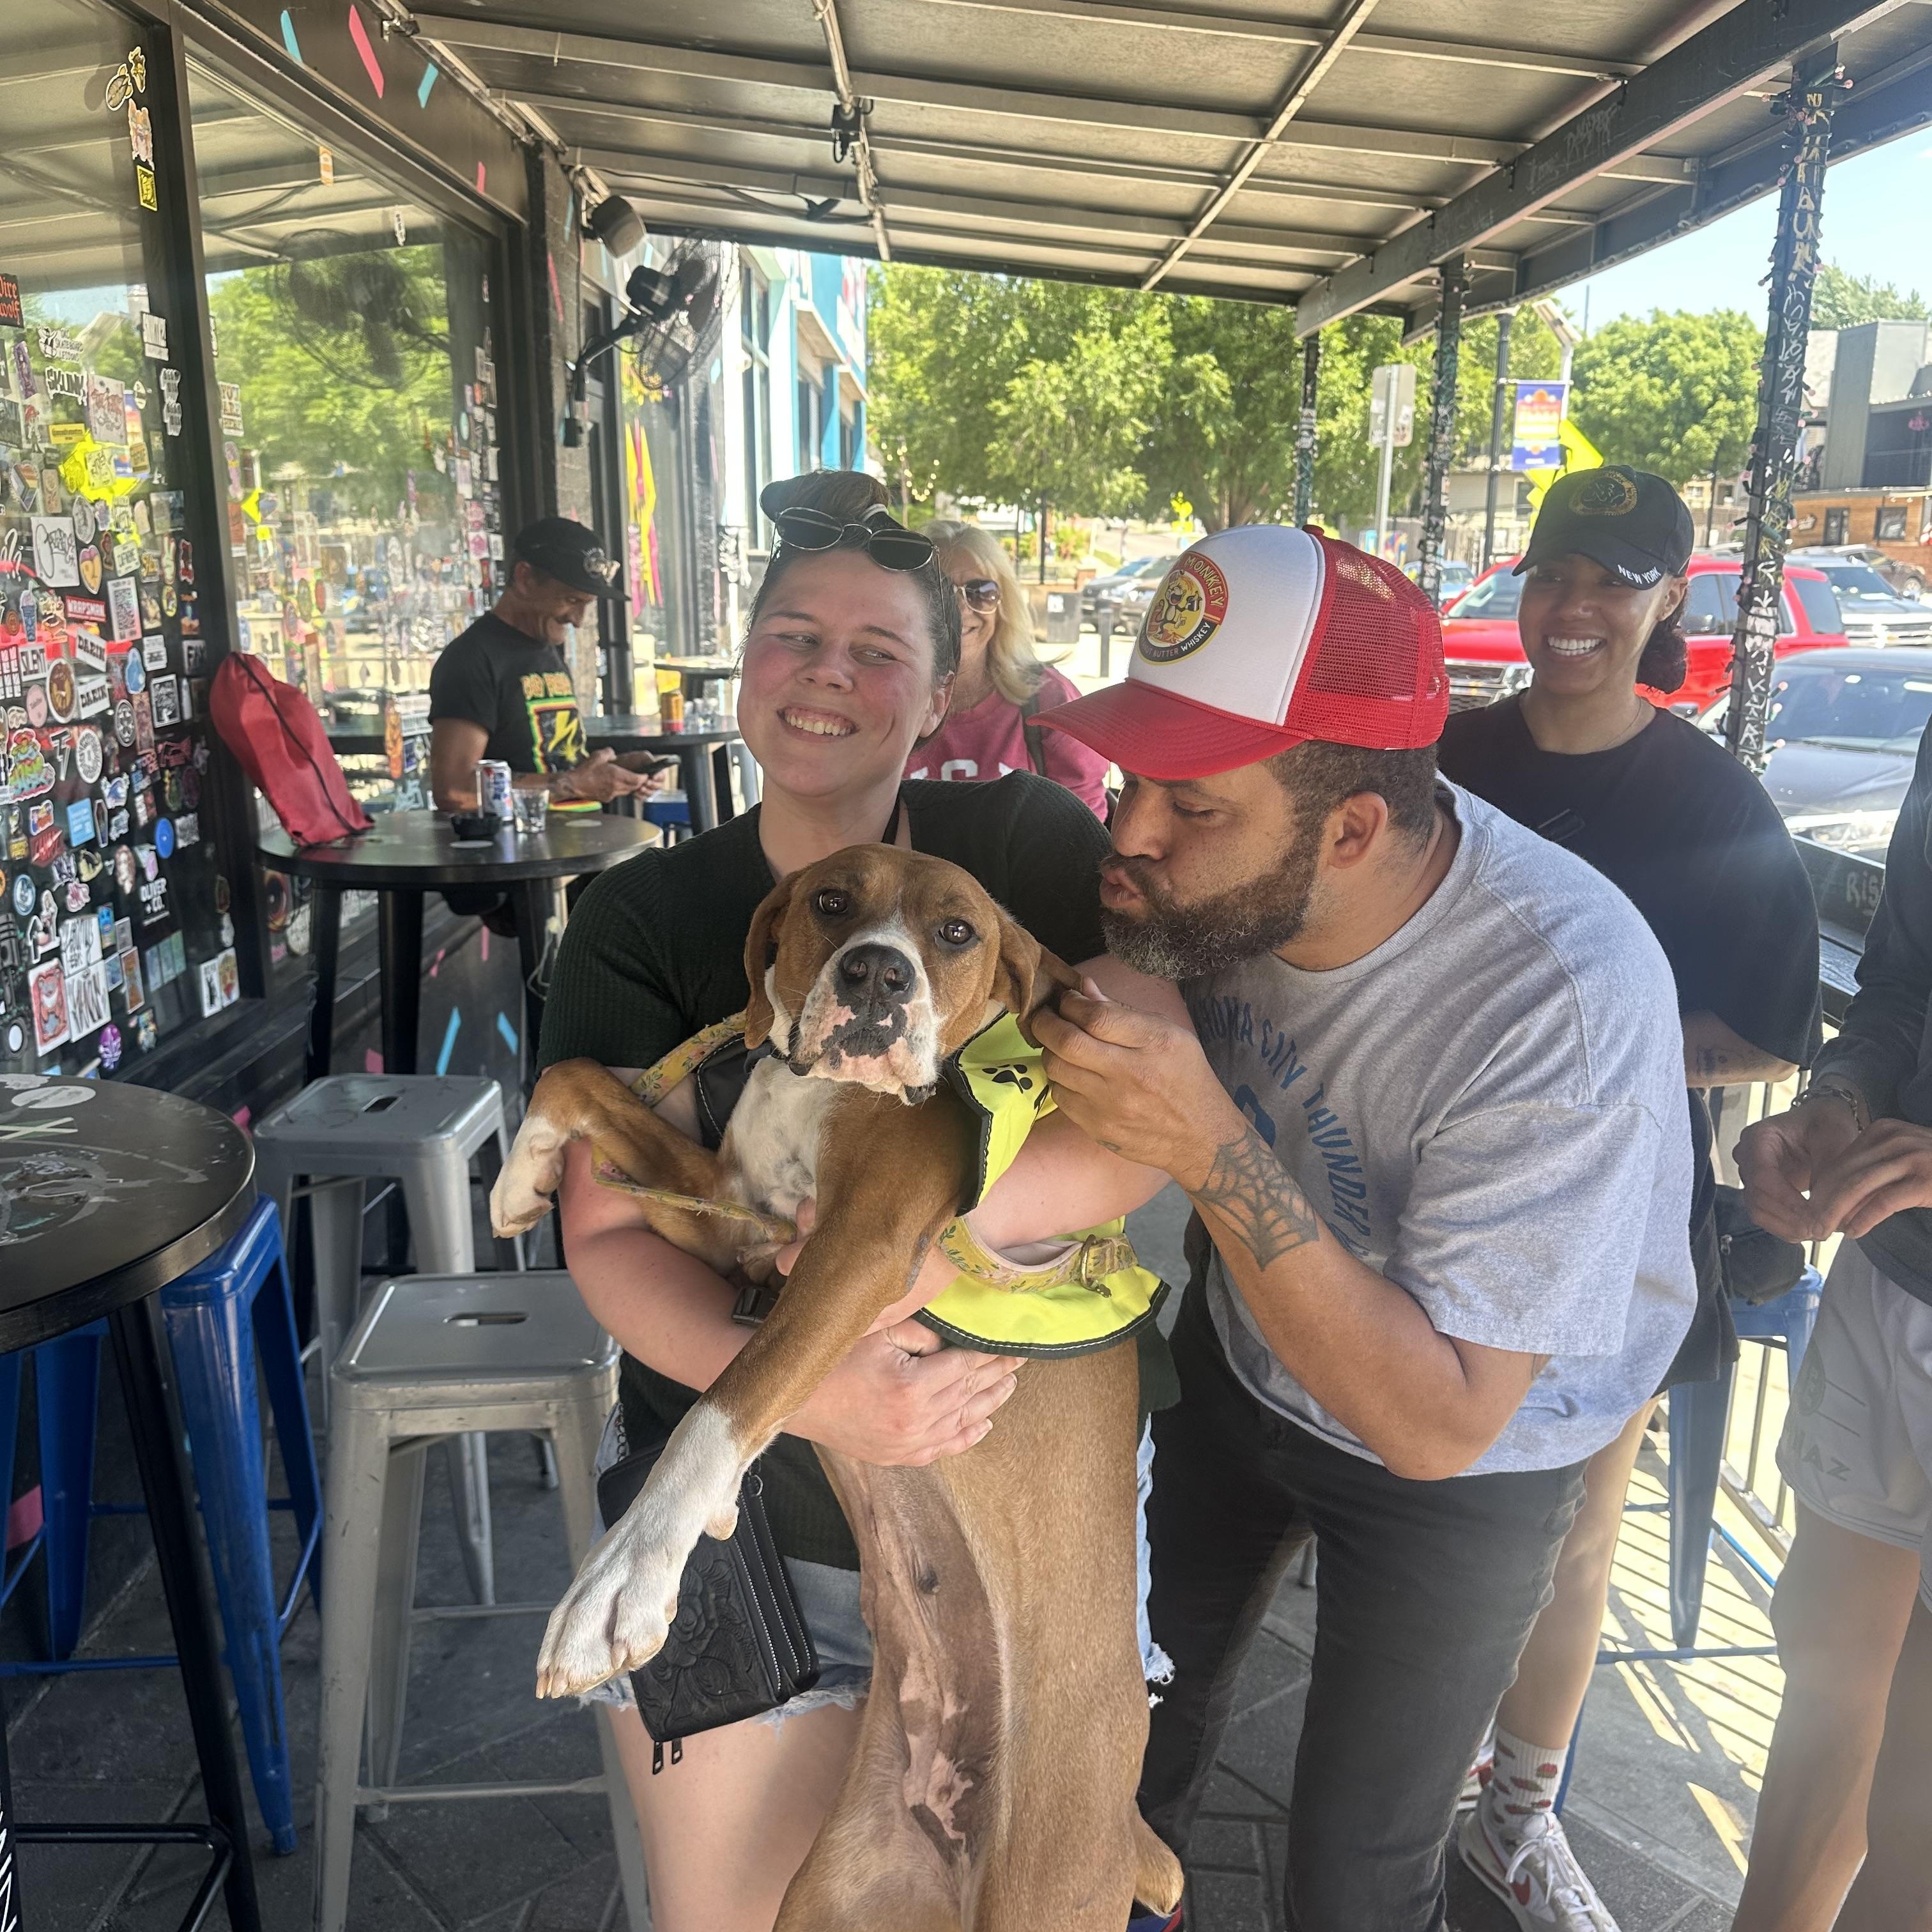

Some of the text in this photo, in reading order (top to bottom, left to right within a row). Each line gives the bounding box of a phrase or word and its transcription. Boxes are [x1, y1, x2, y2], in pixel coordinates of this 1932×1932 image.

[1184, 556, 1226, 607] MONKEY
[1617, 564, 1661, 585] NEW YORK
[1180, 622, 1211, 652] WHISKEY
[1193, 996, 1254, 1046] HOMA
[1261, 1018, 1308, 1090] CITY
[1302, 1083, 1371, 1237] THUNDER
